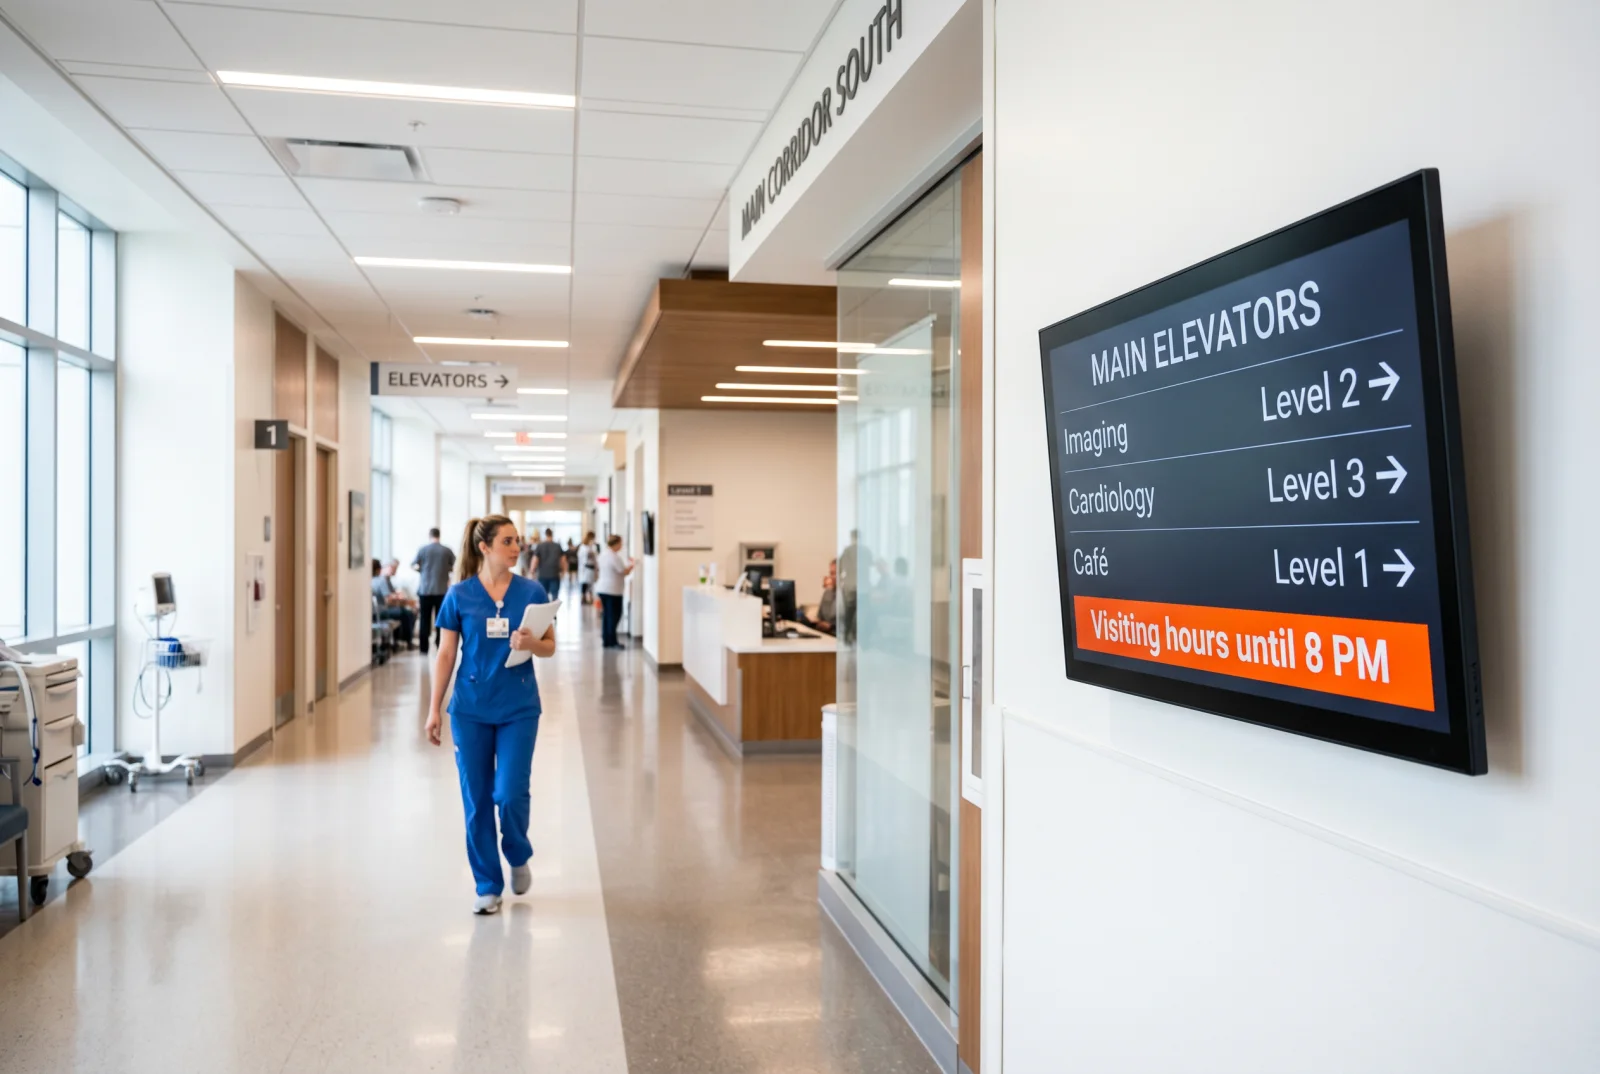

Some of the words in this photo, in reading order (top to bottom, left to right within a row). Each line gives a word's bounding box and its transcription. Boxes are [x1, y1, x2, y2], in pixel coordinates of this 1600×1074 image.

[741, 178, 765, 241] MAIN
[768, 87, 832, 204] CORRIDOR
[836, 0, 902, 116] SOUTH
[1091, 337, 1148, 387] MAIN
[1154, 280, 1321, 369] ELEVATORS
[387, 371, 488, 388] ELEVATORS
[1064, 420, 1128, 458] Imaging
[1260, 370, 1331, 422] Level
[1339, 367, 1361, 409] 2
[266, 425, 277, 446] 1
[1069, 481, 1155, 519] Cardiology
[1267, 458, 1338, 503] Level
[1346, 457, 1366, 498] 3
[1073, 547, 1109, 576] Café
[1273, 546, 1344, 587] Level
[1354, 548, 1369, 588] 1
[1090, 608, 1161, 657] Visiting
[1165, 616, 1229, 660] hours
[1235, 628, 1296, 670] until
[1304, 631, 1324, 674] 8
[1332, 634, 1390, 684] PM
